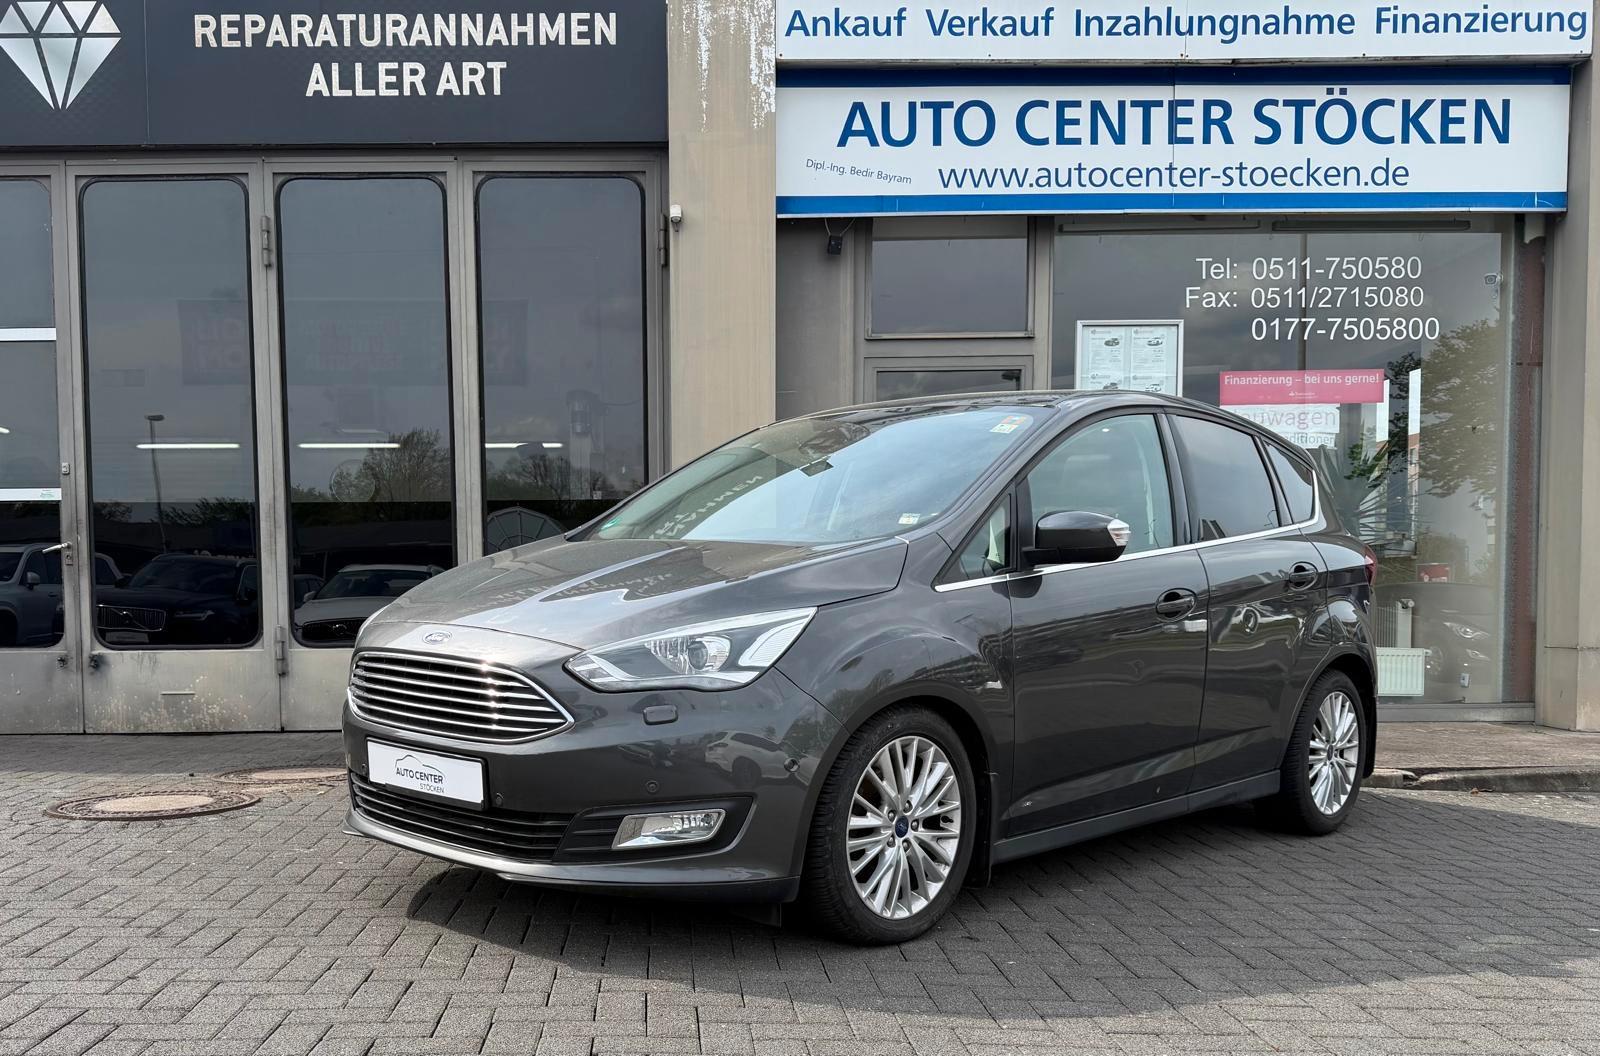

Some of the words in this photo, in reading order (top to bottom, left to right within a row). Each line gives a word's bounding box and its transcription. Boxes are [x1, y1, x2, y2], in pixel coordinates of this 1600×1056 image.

[194, 13, 617, 48] REPARATURANNAHMEN
[785, 7, 906, 37] Ankauf
[926, 7, 1054, 37] Verkauf
[1075, 6, 1355, 44] Inzahlungnahme
[1375, 5, 1587, 40] Finanzierung
[306, 62, 427, 97] ALLER
[436, 61, 507, 96] ART
[836, 100, 996, 148] AUTO
[1015, 99, 1235, 146] CENTER
[1253, 87, 1511, 145] STÖCKEN
[806, 158, 847, 176] Dipl.-Ing.
[849, 166, 875, 178] Bedir
[876, 170, 912, 184] Bayram
[938, 158, 1409, 189] www.autocenter-stoecken.de
[1195, 257, 1238, 280] Tel:
[1252, 256, 1422, 280] 0511-750580
[1185, 286, 1238, 308] Fax:
[1251, 286, 1424, 309] 0511/2715080
[1251, 317, 1440, 341] 0177-7505800
[1224, 374, 1293, 386] Finanzierung
[1304, 374, 1321, 385] bei
[1323, 375, 1342, 385] uns
[1344, 373, 1379, 386] gerne!
[420, 783, 445, 794] STÖCKEN
